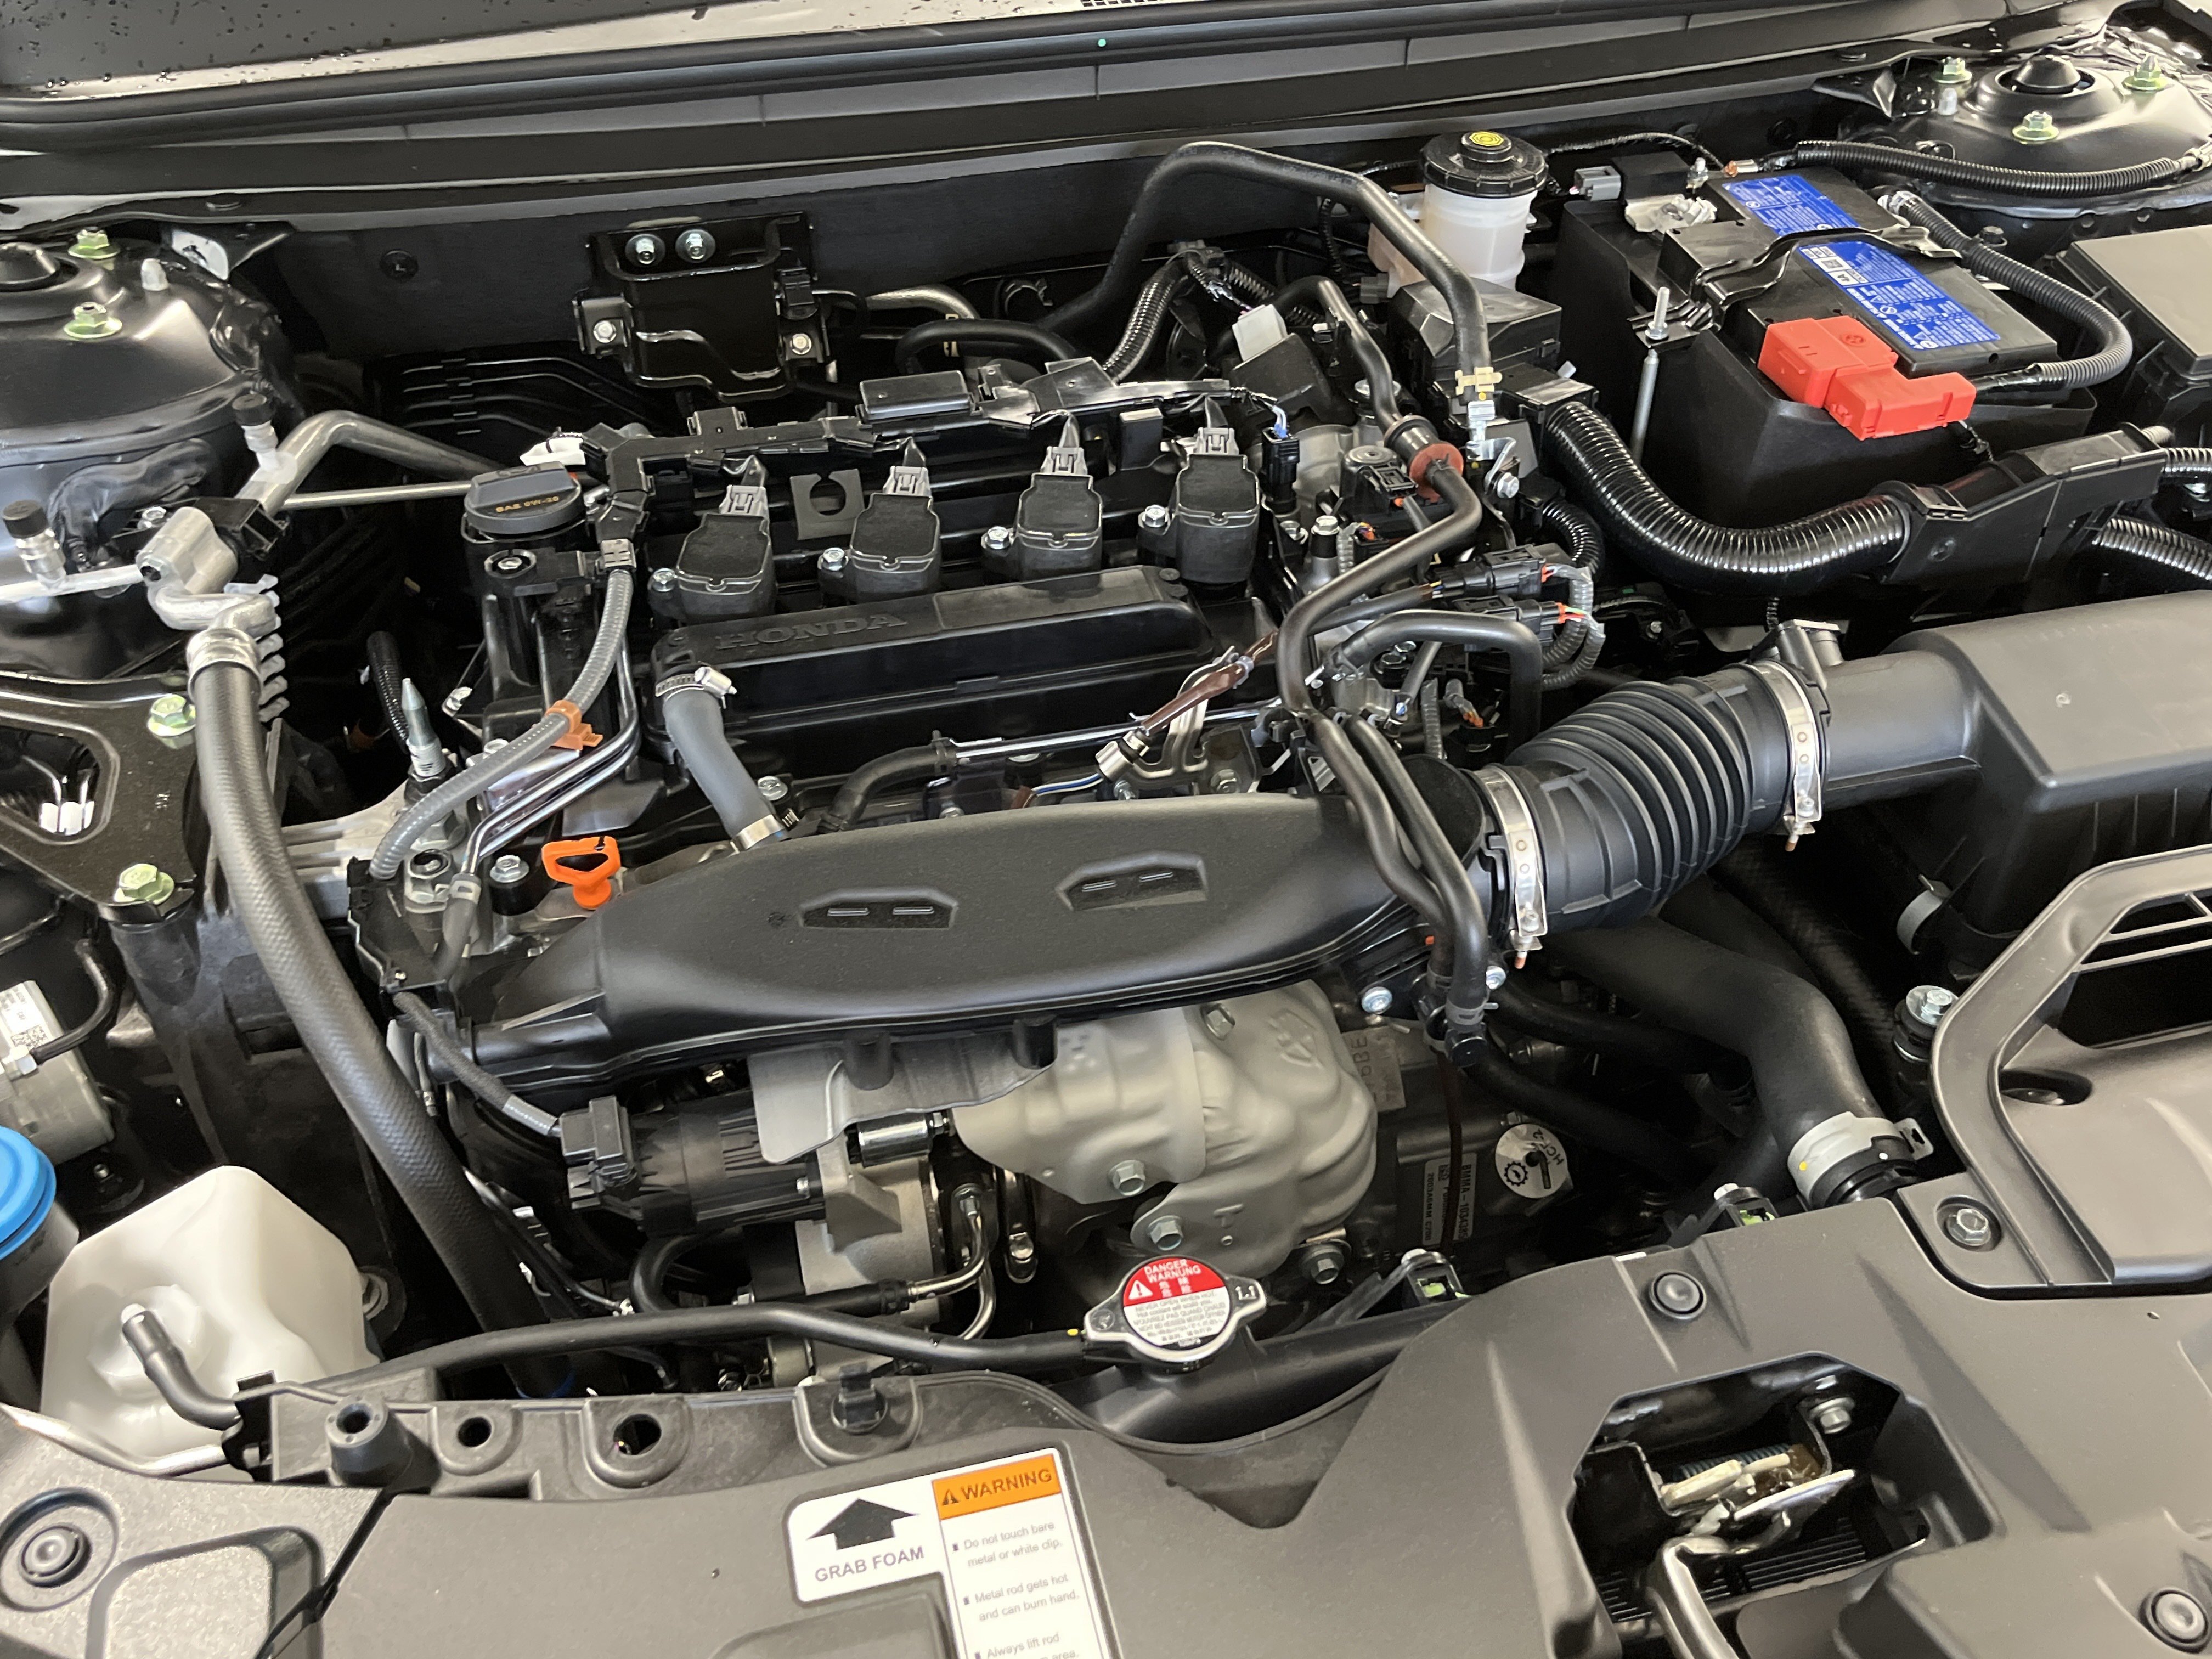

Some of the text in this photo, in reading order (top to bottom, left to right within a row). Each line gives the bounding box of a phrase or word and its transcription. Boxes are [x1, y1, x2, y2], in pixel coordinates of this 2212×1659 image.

[715, 613, 907, 650] HONDA
[1144, 1259, 1188, 1275] DANGER
[1147, 1265, 1201, 1284] WARNUNG
[961, 1468, 1052, 1500] WARNING
[964, 1522, 1054, 1550] Do not touch bare
[815, 1545, 924, 1582] GRAB FOAM
[967, 1538, 1063, 1567] metal or white clip.
[974, 1572, 1069, 1604] Metal rod gets hot
[979, 1589, 1080, 1621] and can burn hand.
[986, 1631, 1060, 1659] Always lift rod
